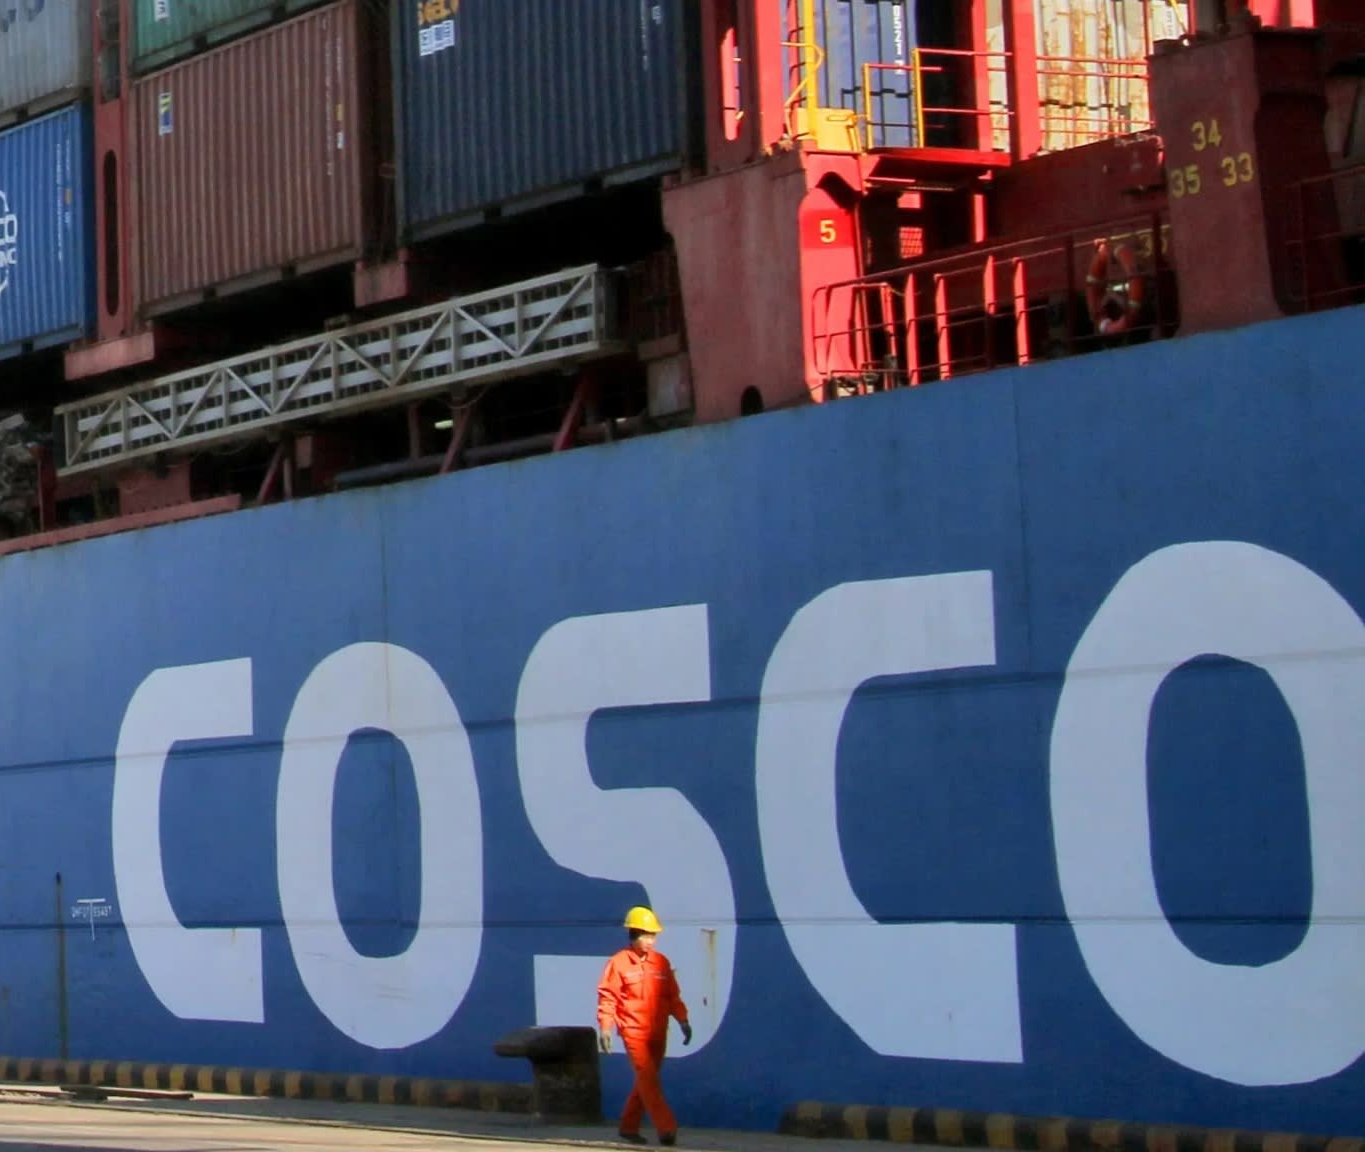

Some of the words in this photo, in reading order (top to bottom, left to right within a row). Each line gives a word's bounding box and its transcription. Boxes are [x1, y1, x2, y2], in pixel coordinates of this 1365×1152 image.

[1191, 119, 1222, 151] 34
[1170, 164, 1201, 197] 35
[1221, 152, 1254, 187] 33
[820, 219, 836, 244] 5
[112, 540, 1365, 1086] COSCO
